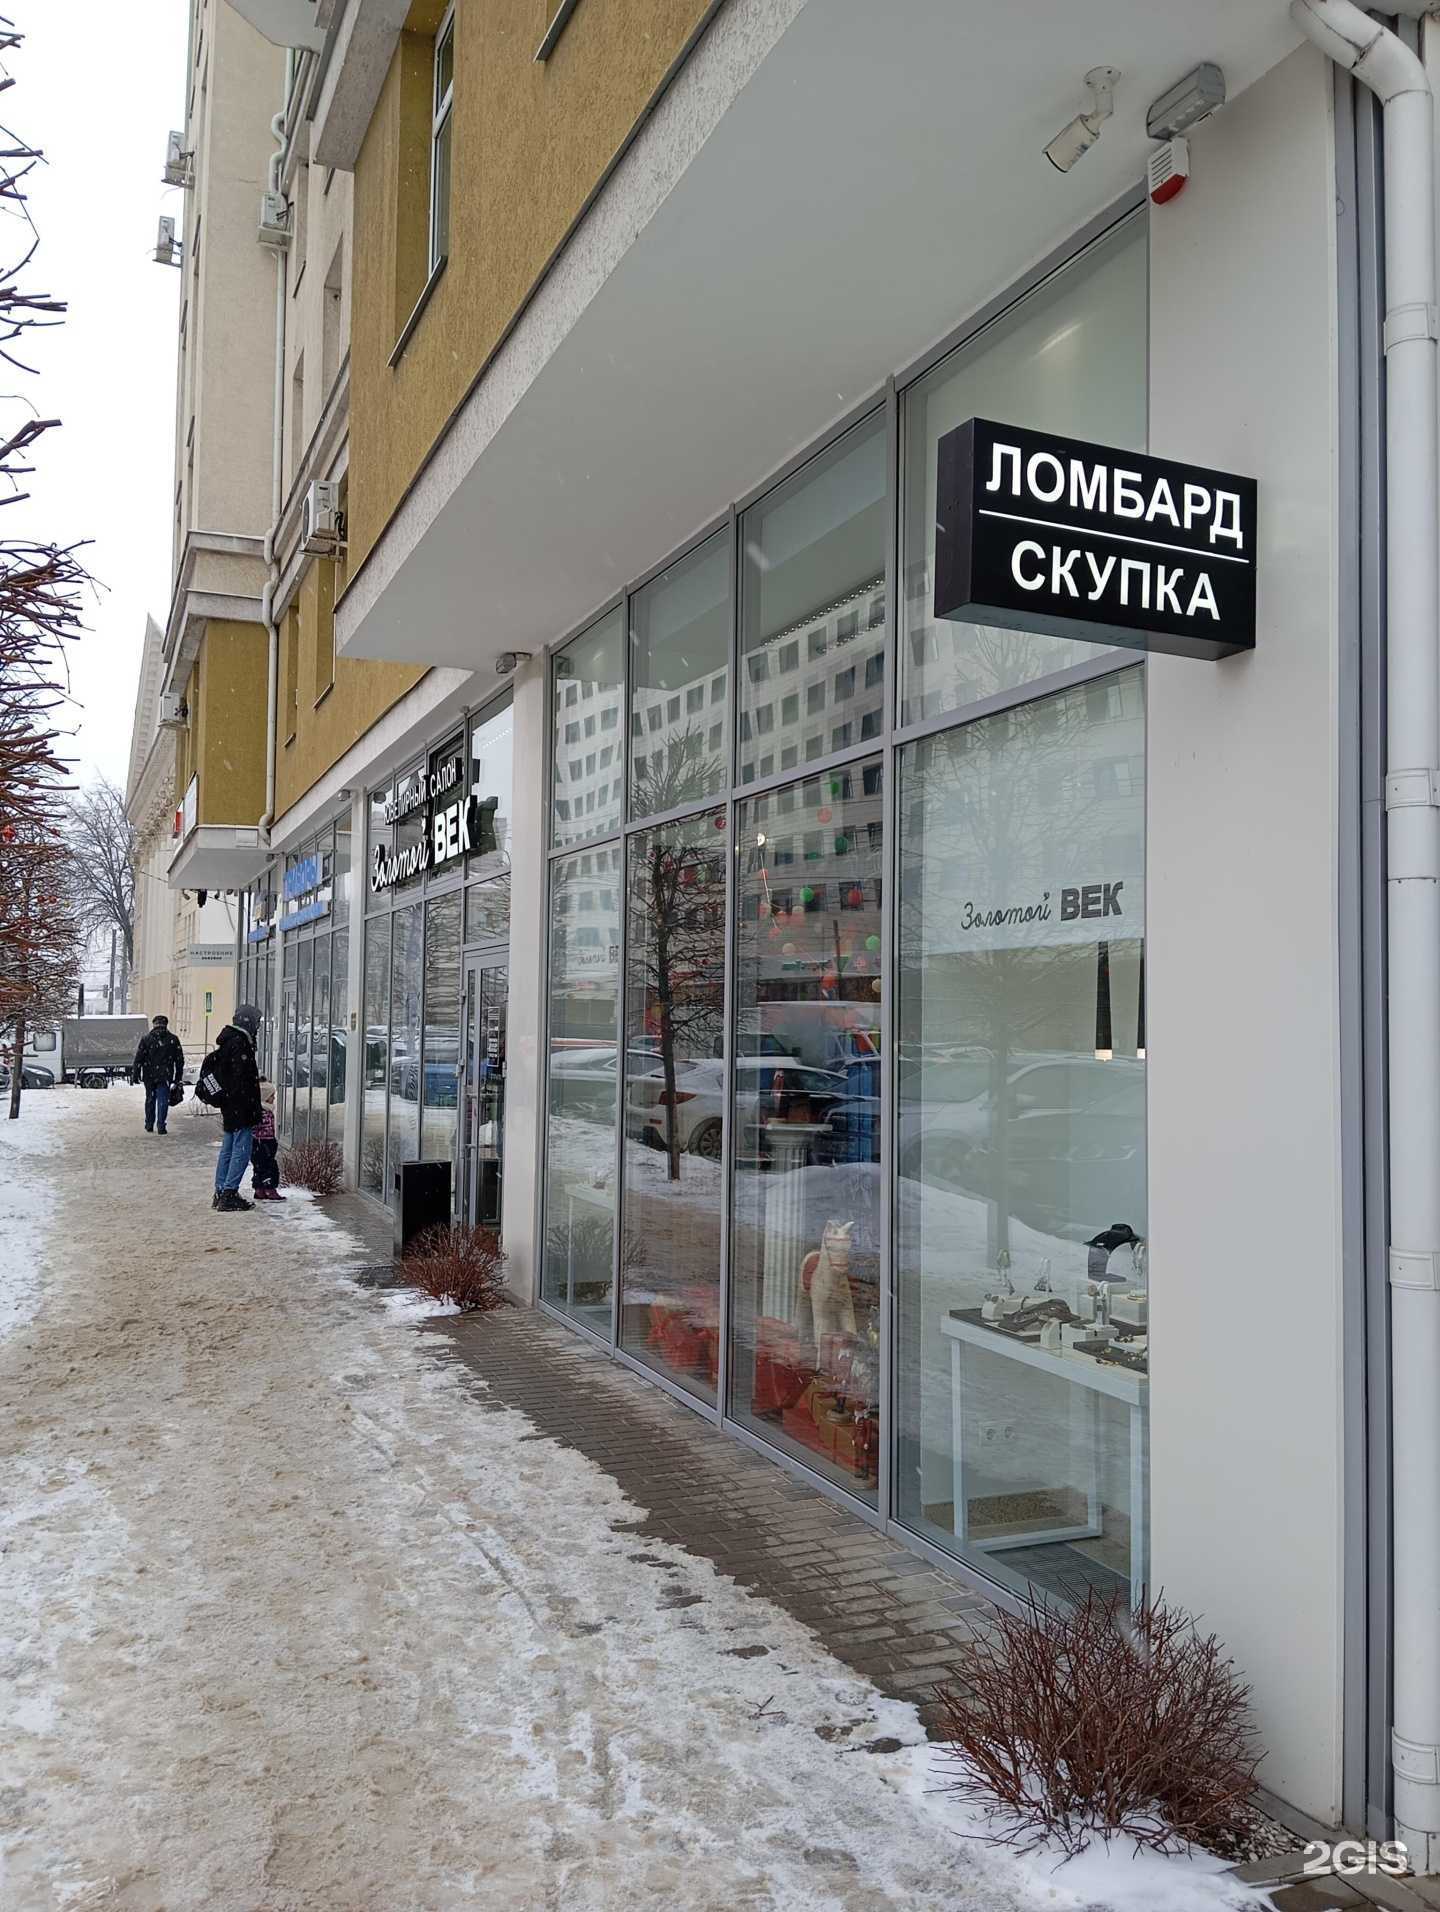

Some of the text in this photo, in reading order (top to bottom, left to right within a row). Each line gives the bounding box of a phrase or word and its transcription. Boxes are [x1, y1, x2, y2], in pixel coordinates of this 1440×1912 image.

[985, 442, 1243, 549] ЛОМБАРД
[1011, 540, 1221, 621] СКУПКА
[429, 757, 457, 797] САЛОН
[371, 817, 430, 892] Золотой
[434, 795, 471, 865] ВЕК
[961, 881, 1124, 930] Золотой ВЕК
